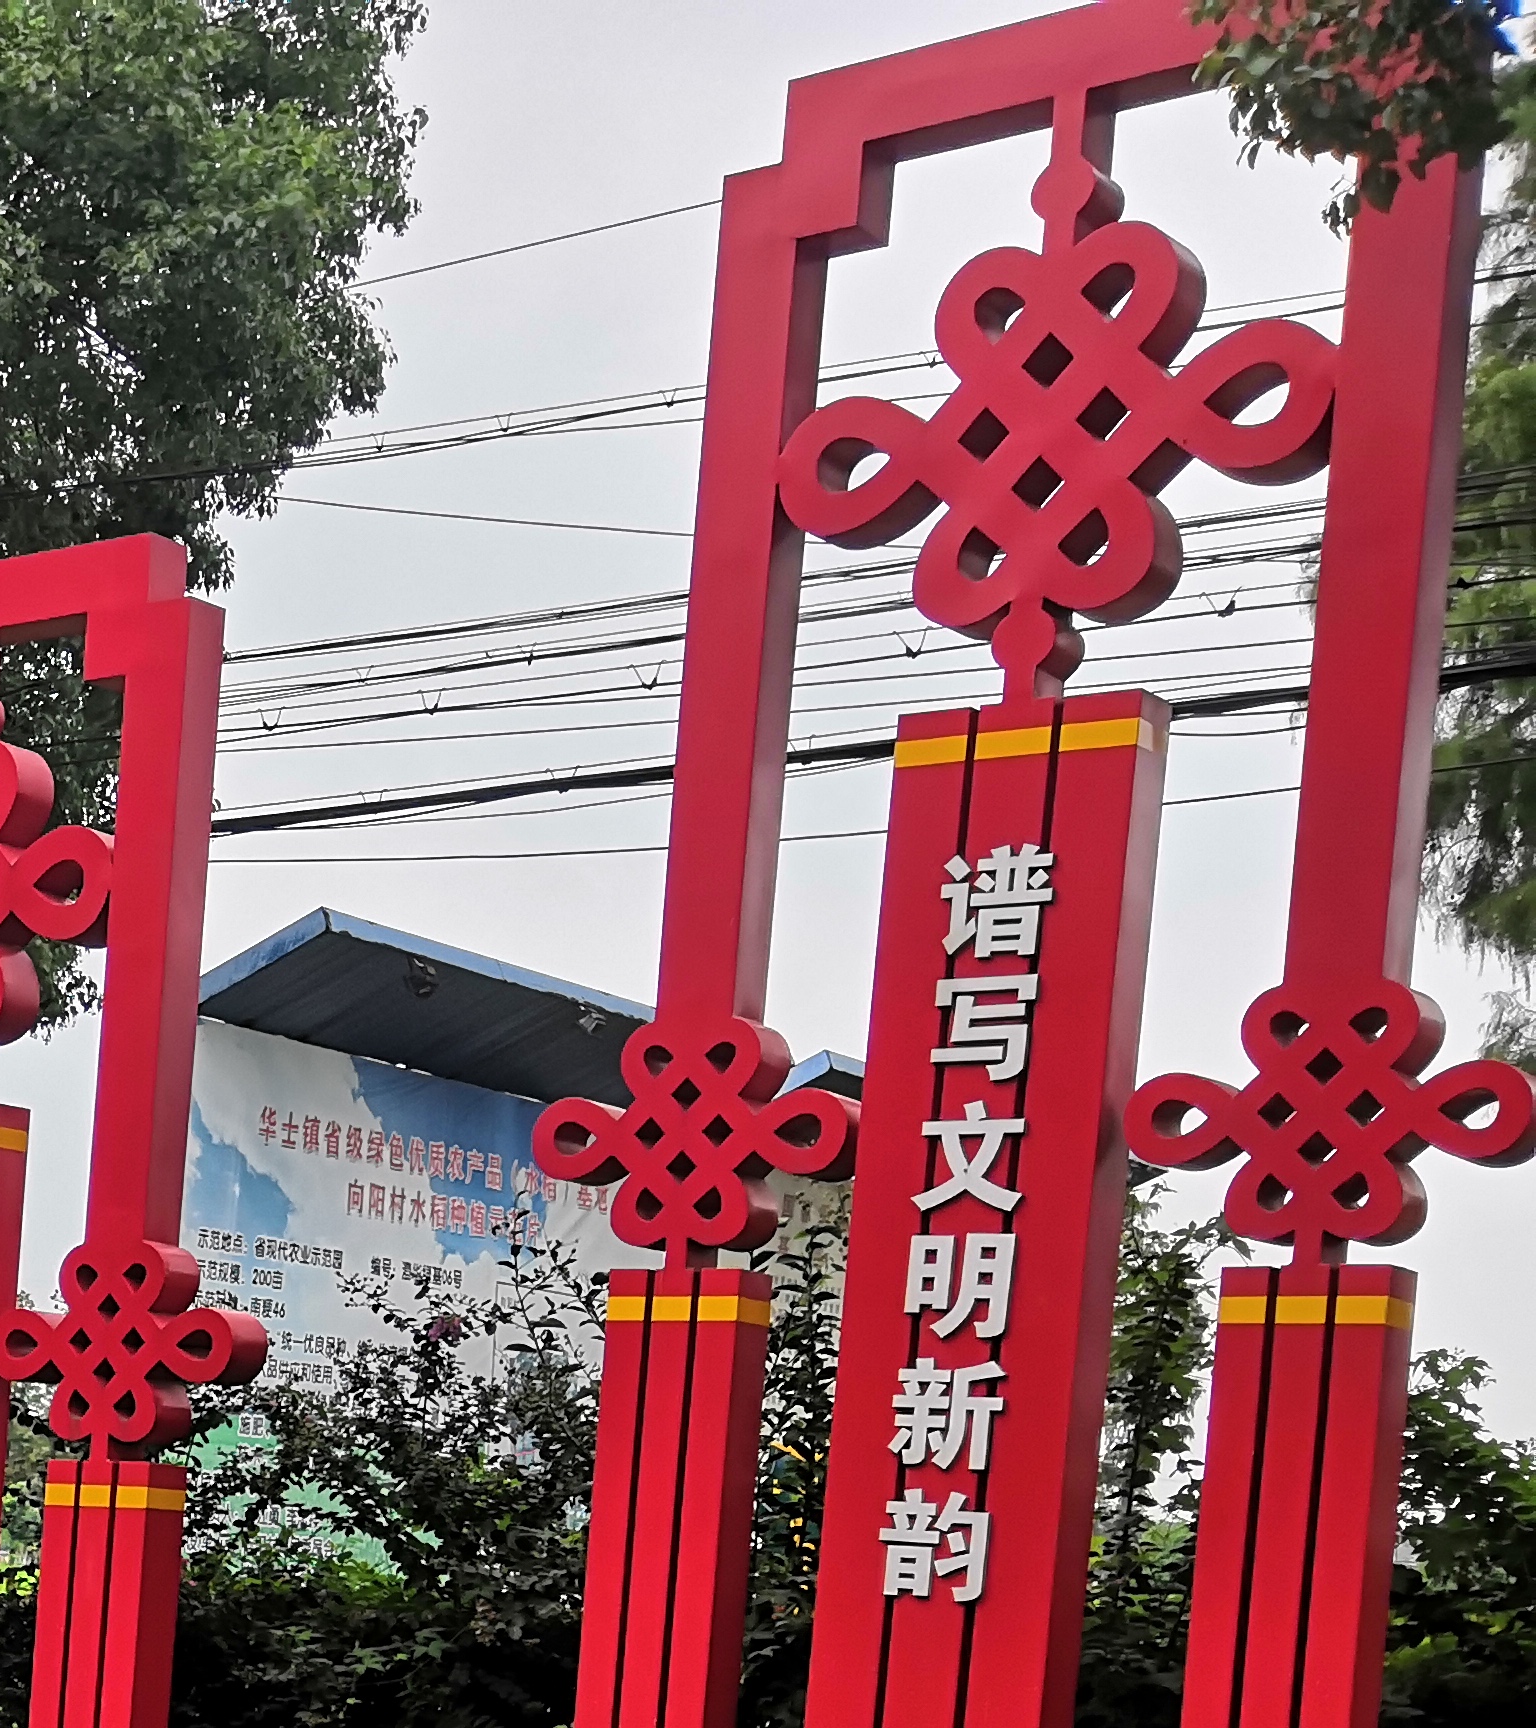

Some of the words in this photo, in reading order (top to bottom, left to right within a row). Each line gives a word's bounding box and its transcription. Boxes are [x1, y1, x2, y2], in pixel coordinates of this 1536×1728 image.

[879, 843, 1054, 1602] 谱写文明新韵
